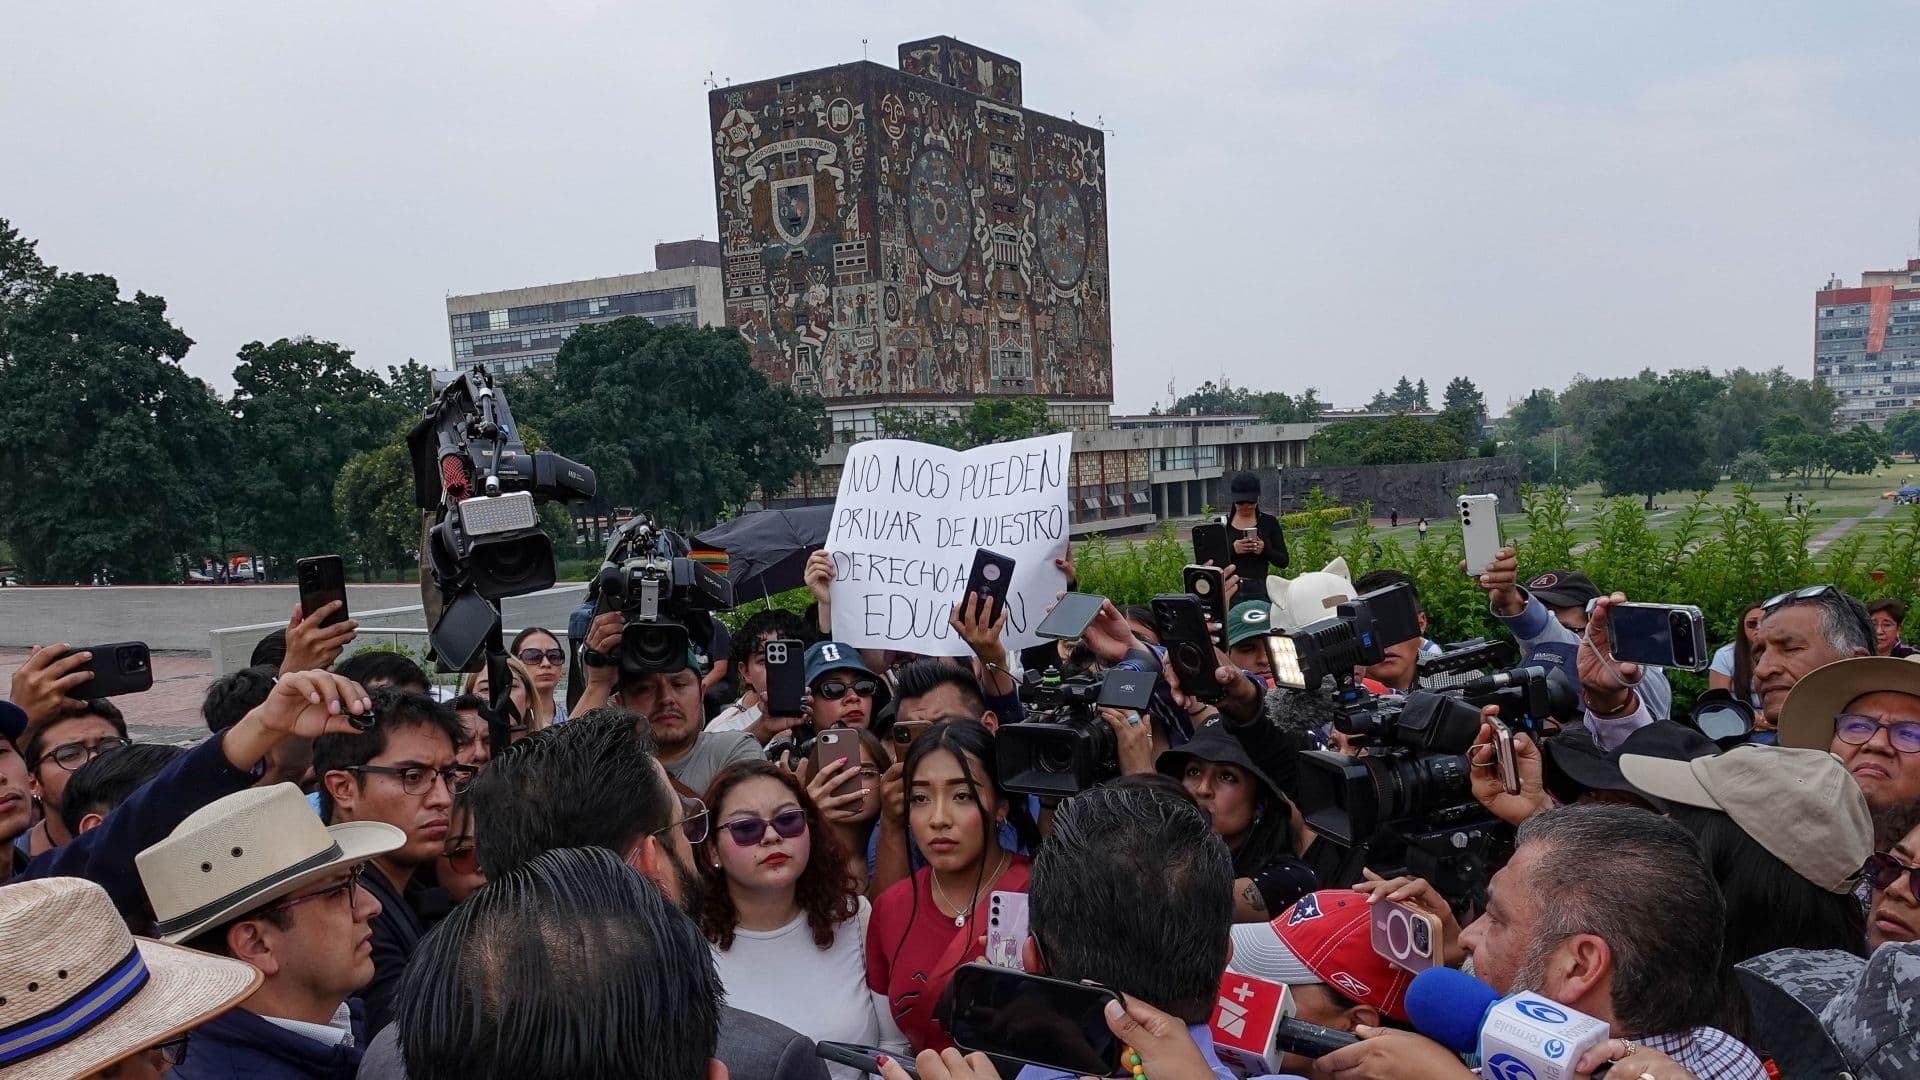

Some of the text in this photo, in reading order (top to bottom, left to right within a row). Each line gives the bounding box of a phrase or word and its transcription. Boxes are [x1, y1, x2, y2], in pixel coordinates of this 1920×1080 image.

[847, 444, 1062, 501] NO NOS PUEDEN
[836, 505, 1063, 548] PRIVAR DE NUESTRO
[832, 550, 949, 593] DERECHO
[863, 592, 1027, 641] EDUCN
